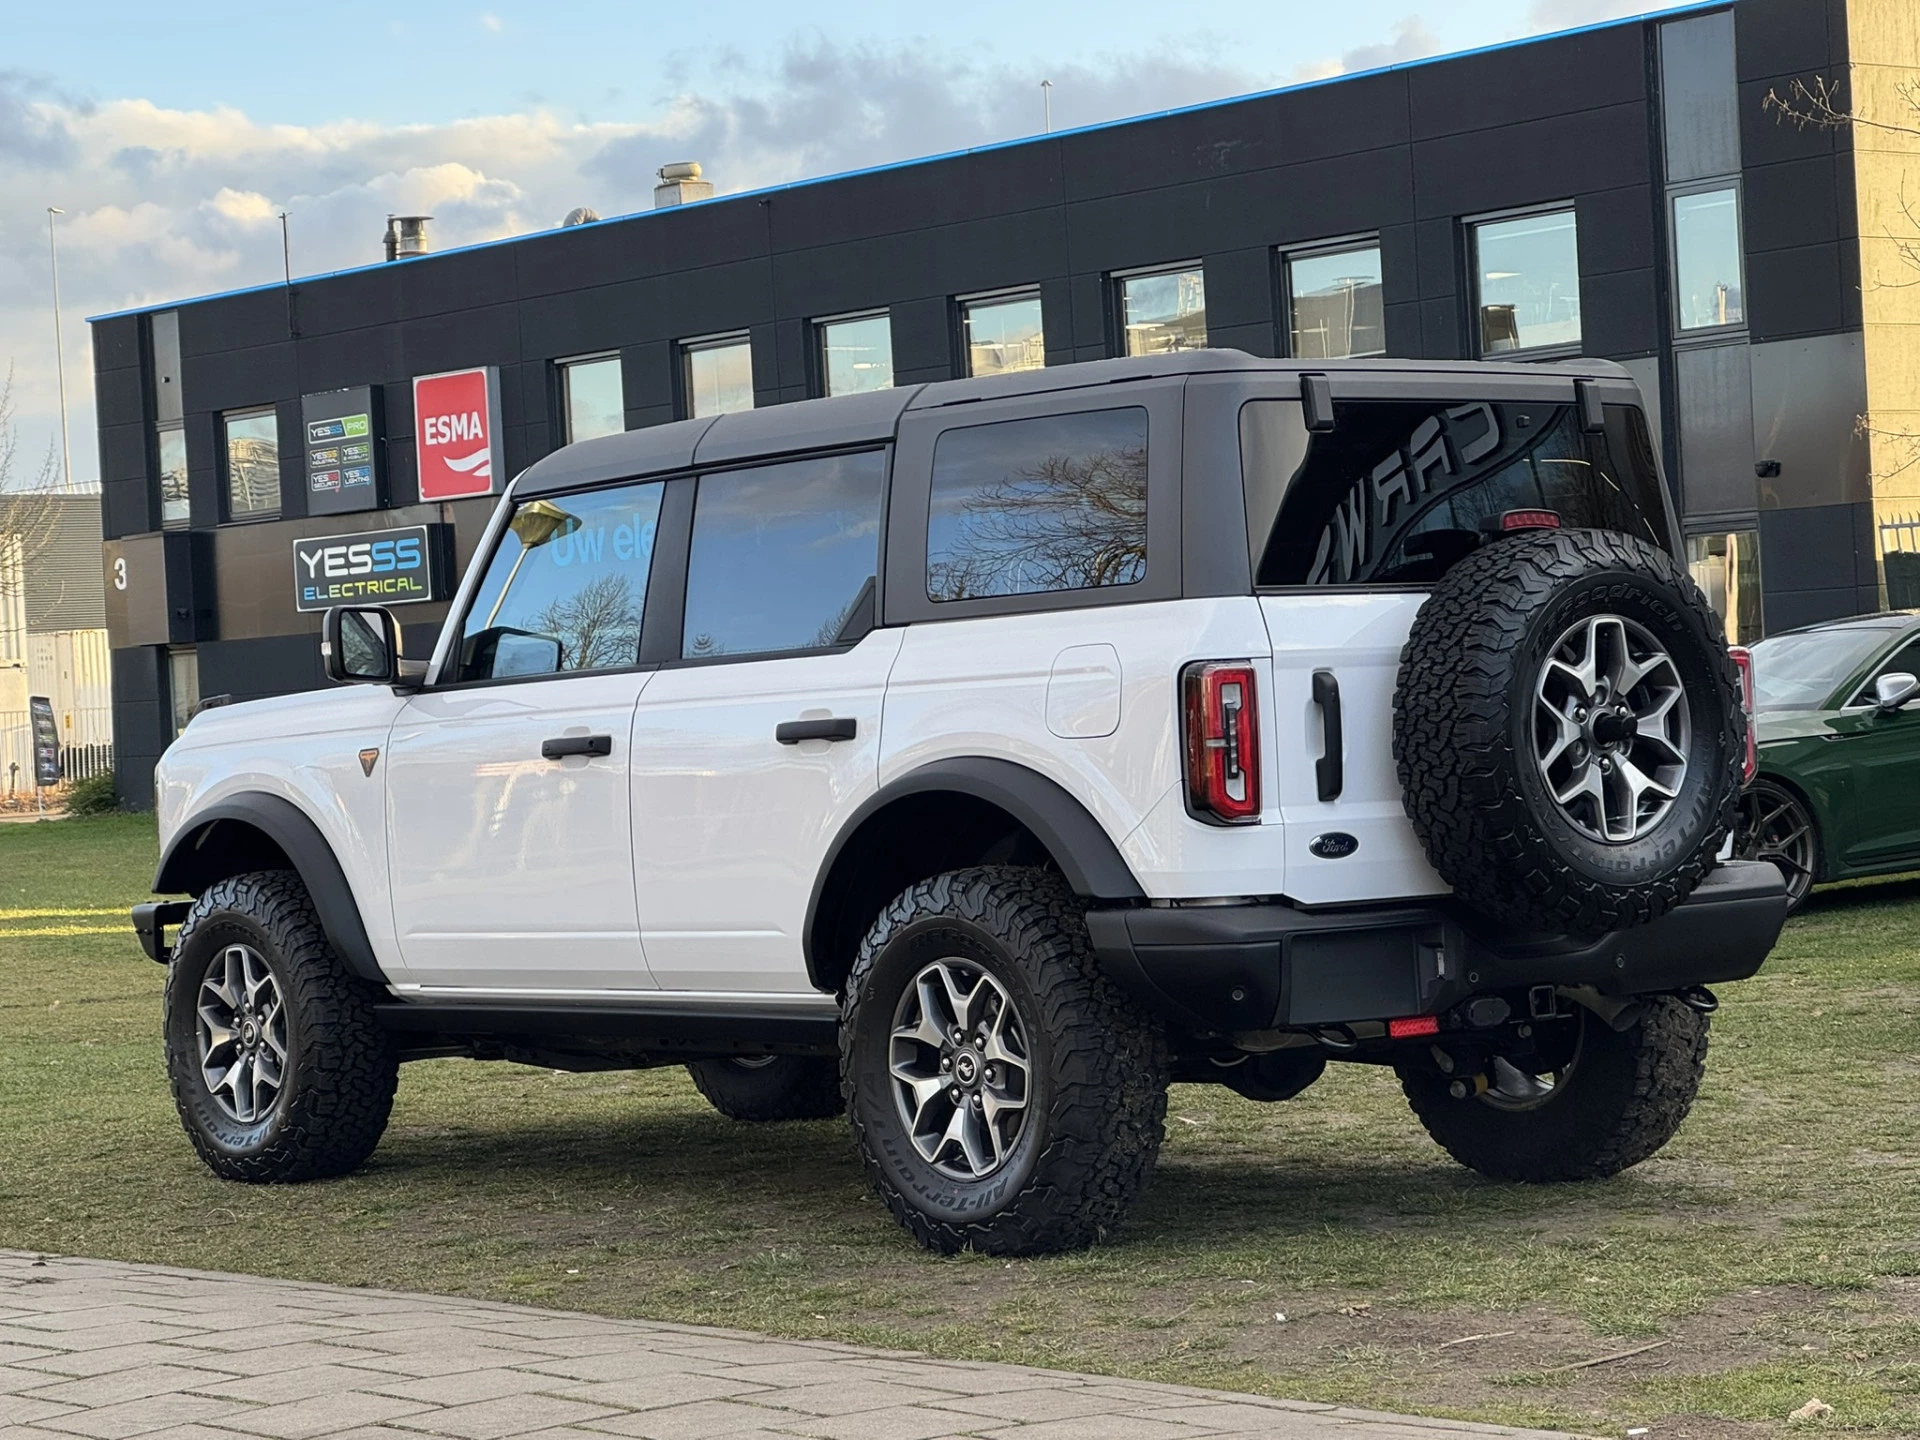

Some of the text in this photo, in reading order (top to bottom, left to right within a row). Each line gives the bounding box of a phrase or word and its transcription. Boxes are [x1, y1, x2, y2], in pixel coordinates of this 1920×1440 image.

[311, 421, 365, 436] YESSS PRO
[424, 411, 483, 446] ESMA
[300, 537, 422, 579] YESSS
[551, 517, 606, 567] Uw
[114, 557, 128, 590] 3
[303, 577, 424, 601] ELECTRICAL
[1322, 838, 1350, 854] Ford
[881, 1137, 1010, 1213] All-Terrain
